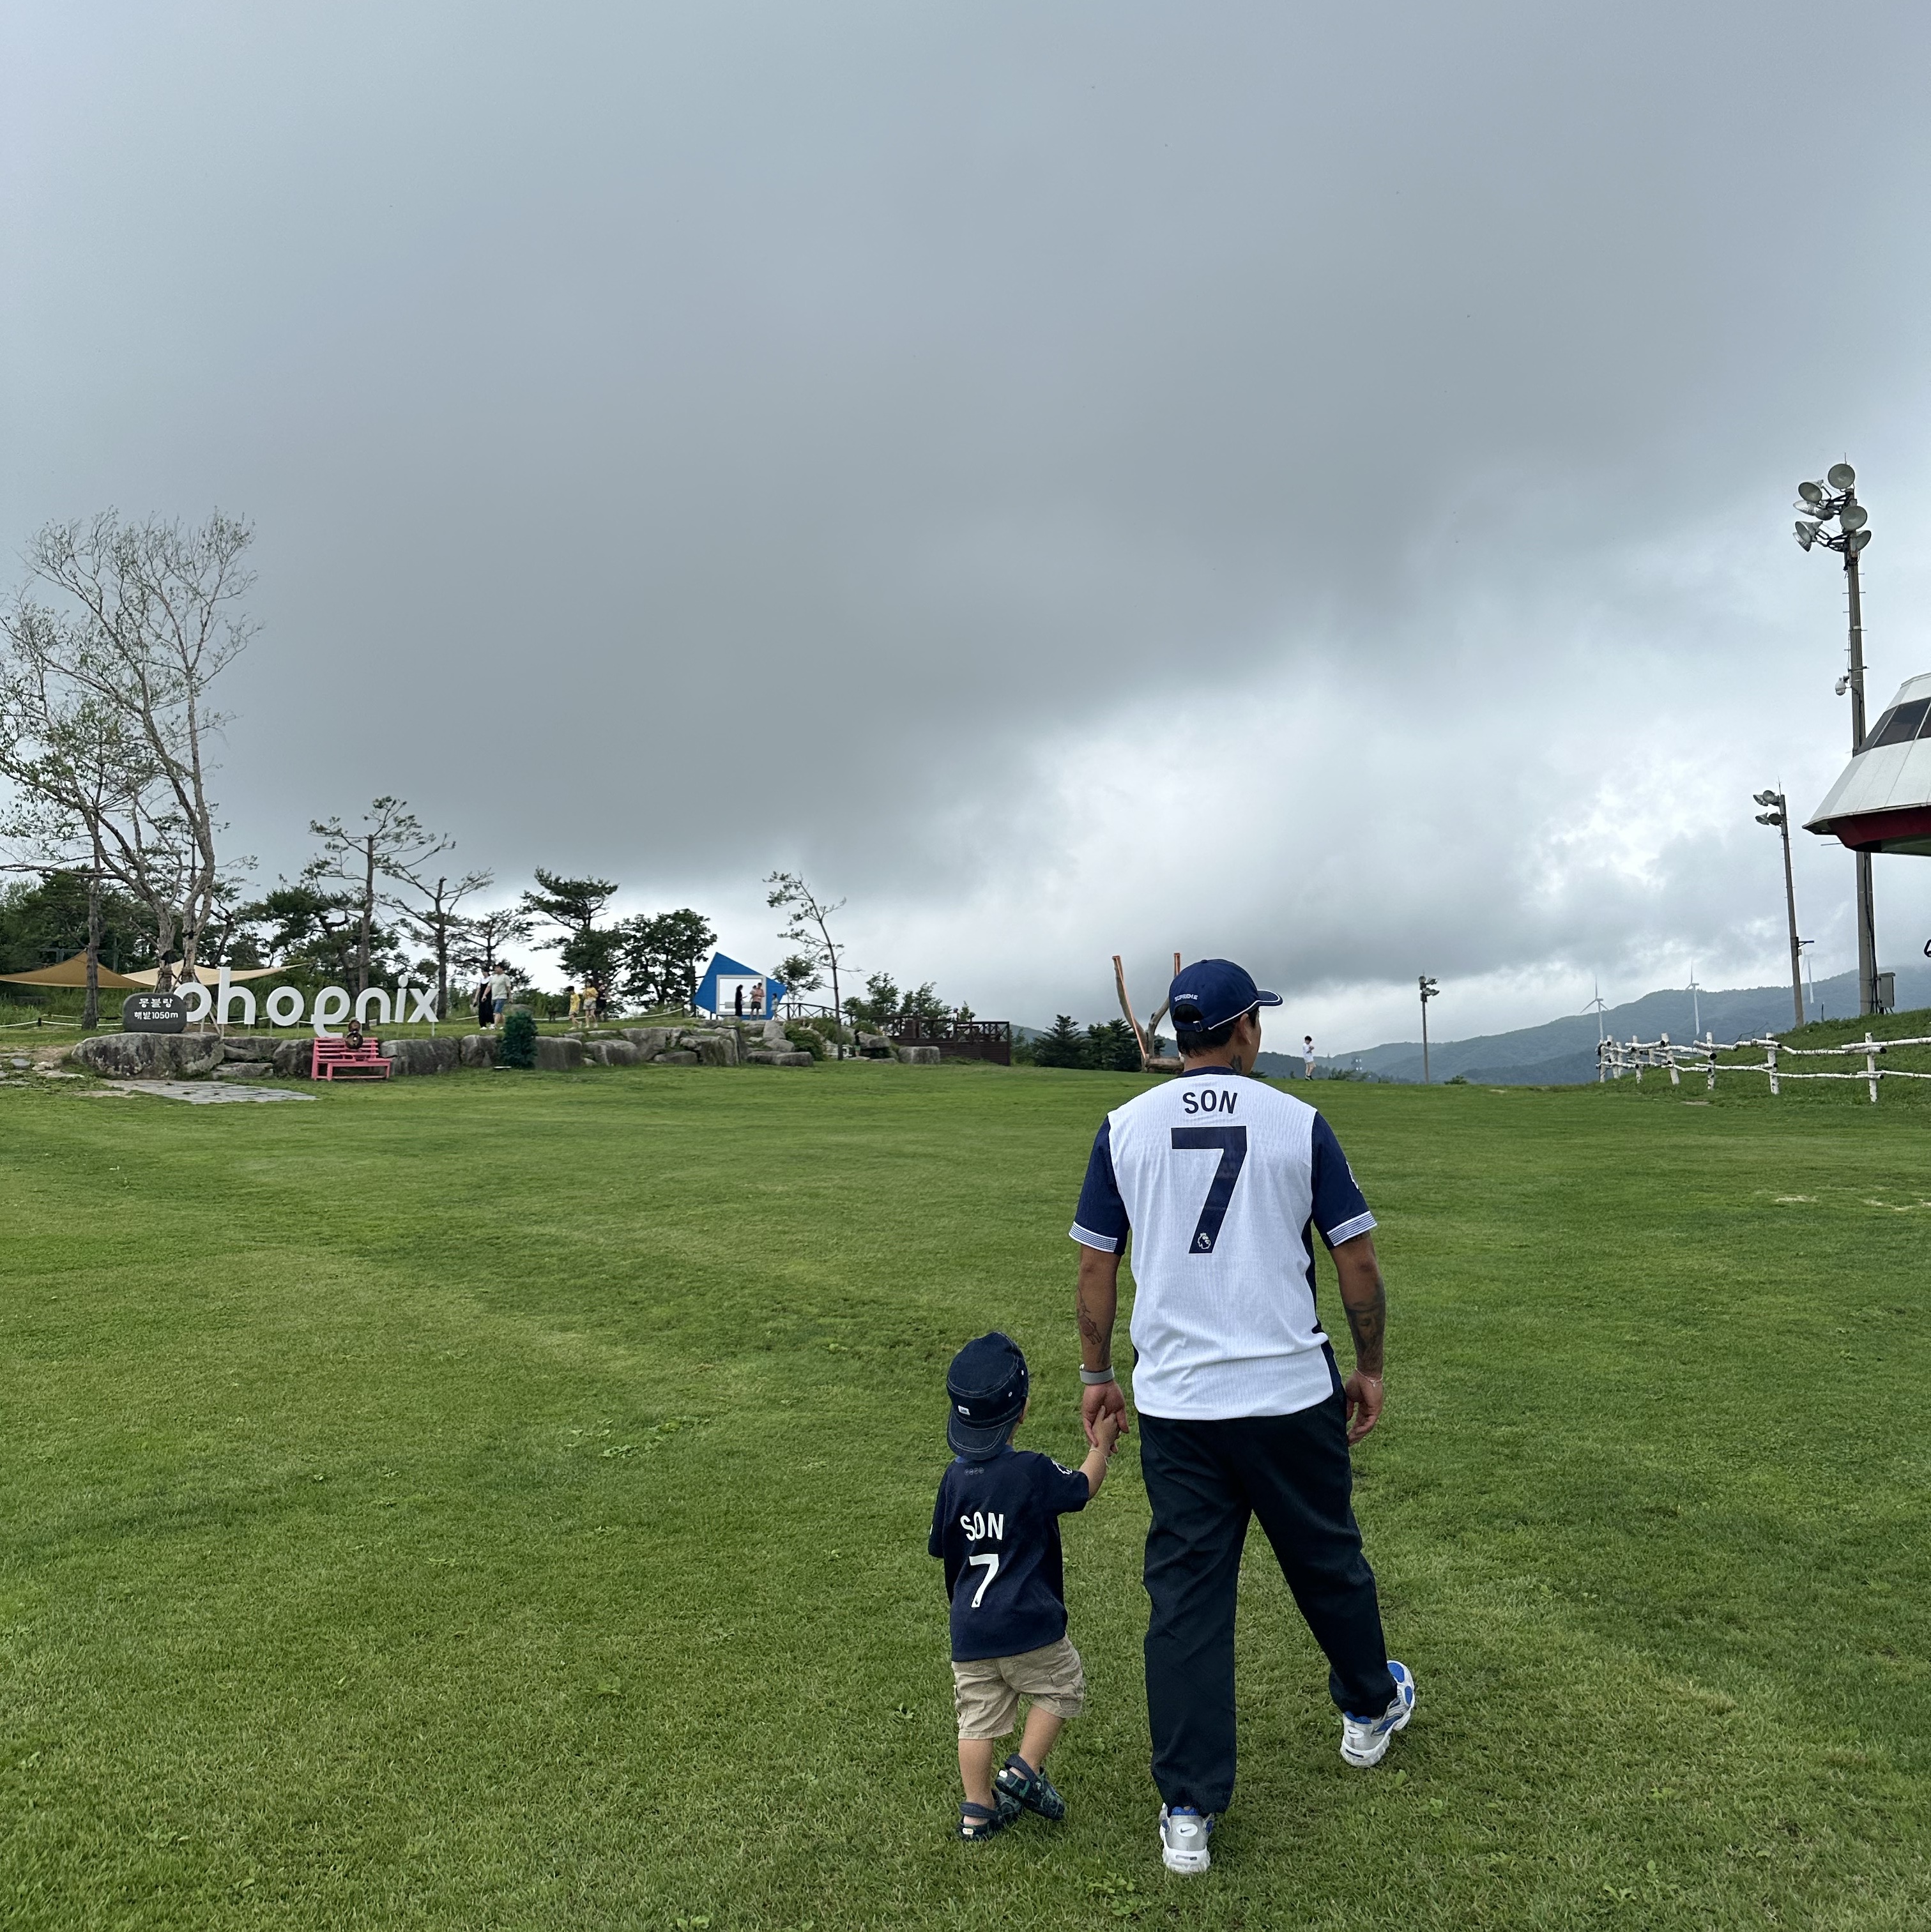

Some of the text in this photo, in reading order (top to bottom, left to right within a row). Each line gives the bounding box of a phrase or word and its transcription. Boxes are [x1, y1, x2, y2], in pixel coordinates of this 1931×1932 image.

[1182, 1090, 1237, 1114] SON
[1171, 1125, 1248, 1254] 7
[960, 1511, 1004, 1540] SON
[968, 1553, 999, 1608] 7
